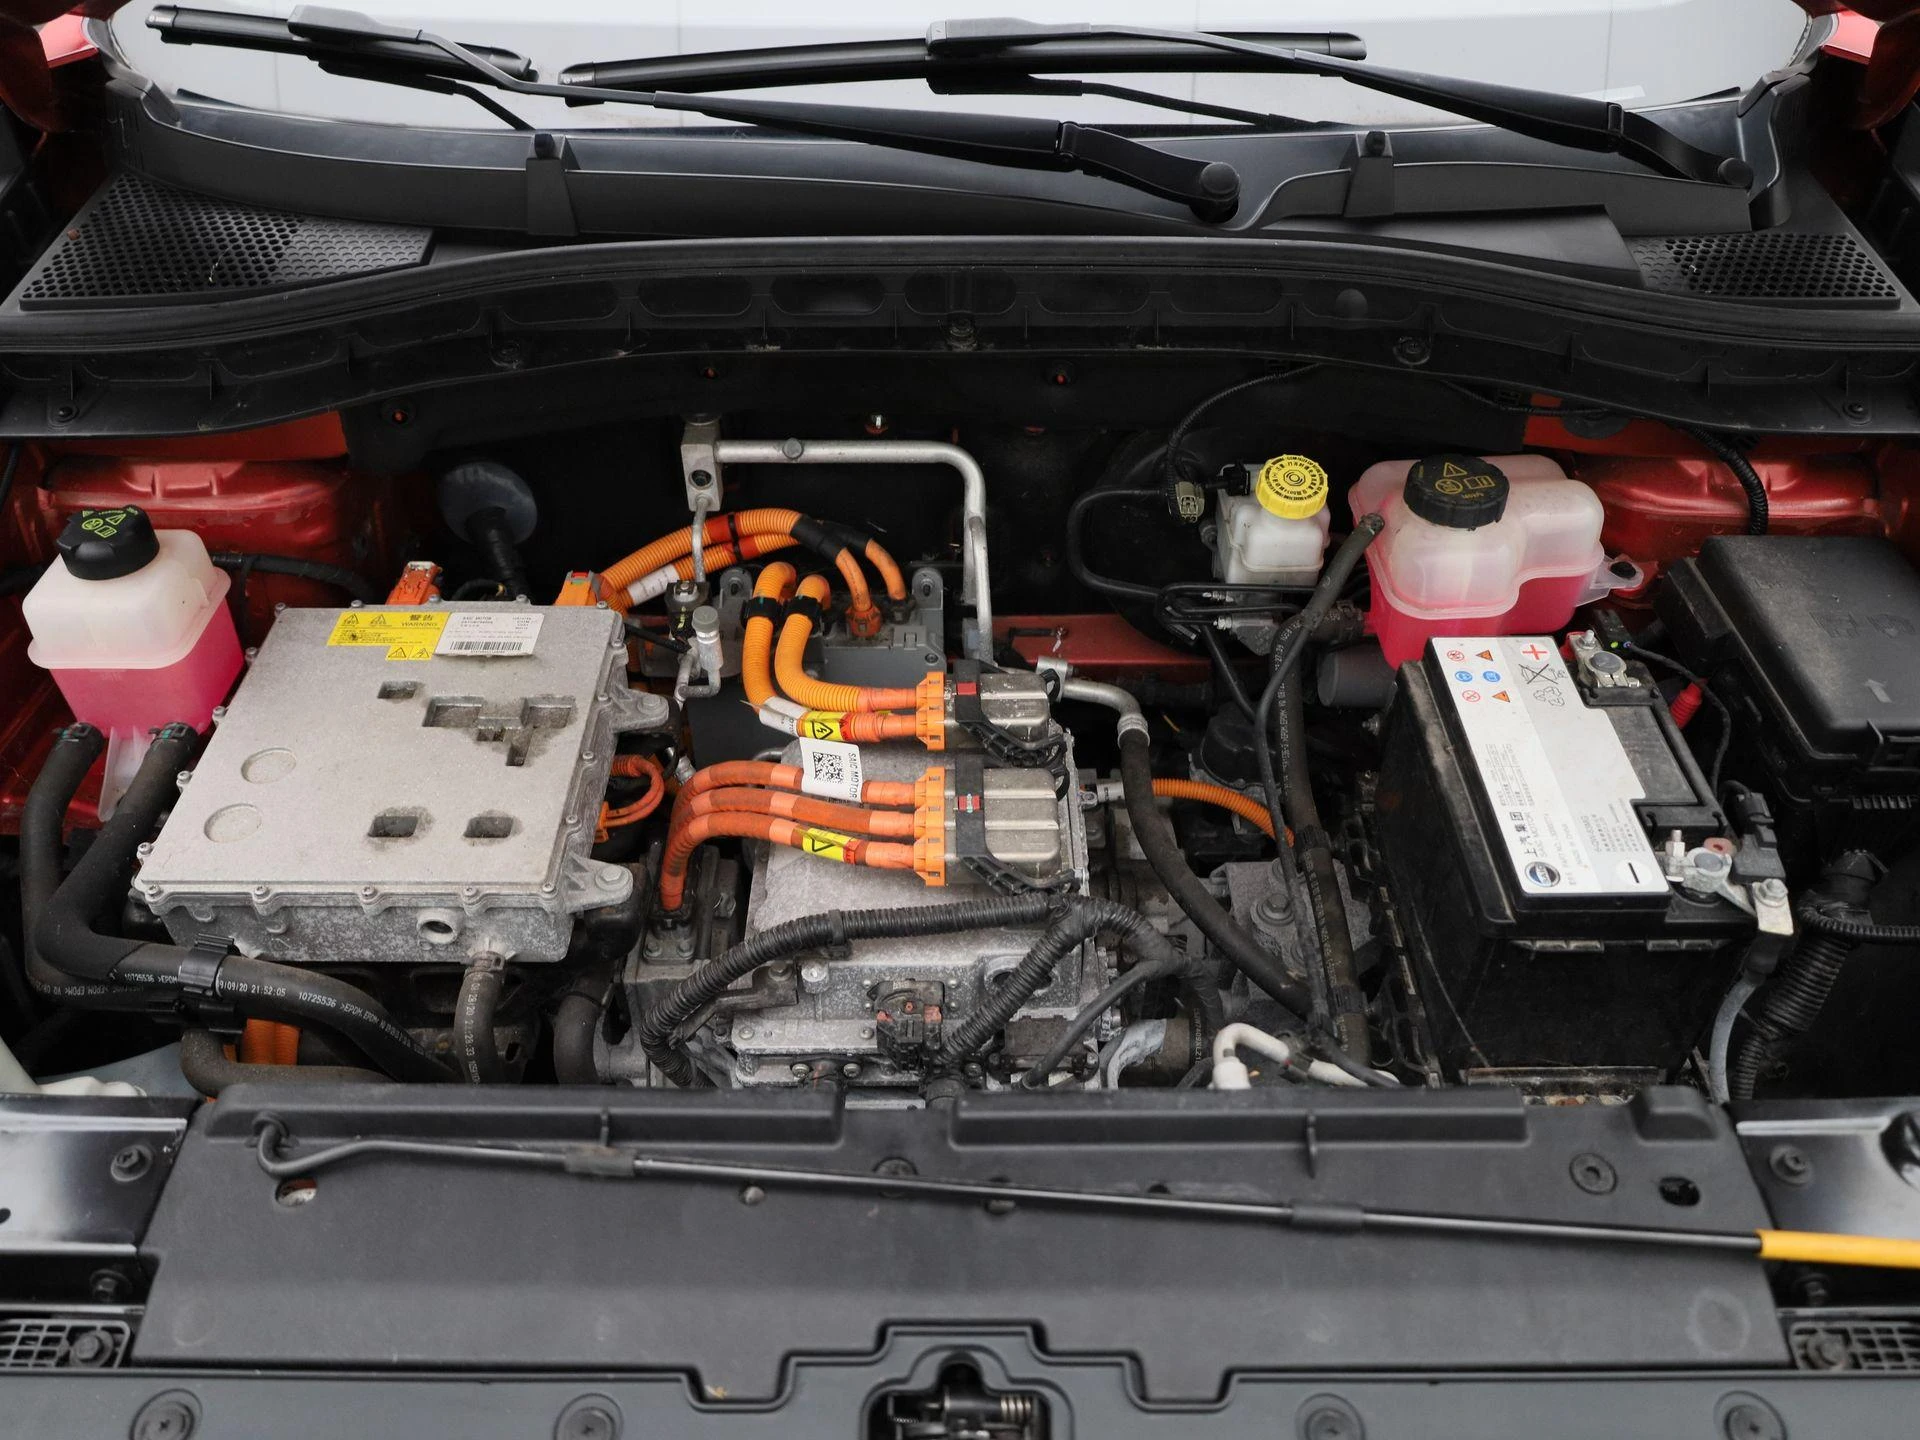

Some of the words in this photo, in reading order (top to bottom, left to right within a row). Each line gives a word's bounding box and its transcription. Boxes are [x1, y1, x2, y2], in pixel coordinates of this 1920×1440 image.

[848, 752, 858, 769] SAIC
[850, 771, 860, 798] MOTOR
[251, 984, 287, 997] 21:52:05
[299, 991, 337, 1008] 10725536
